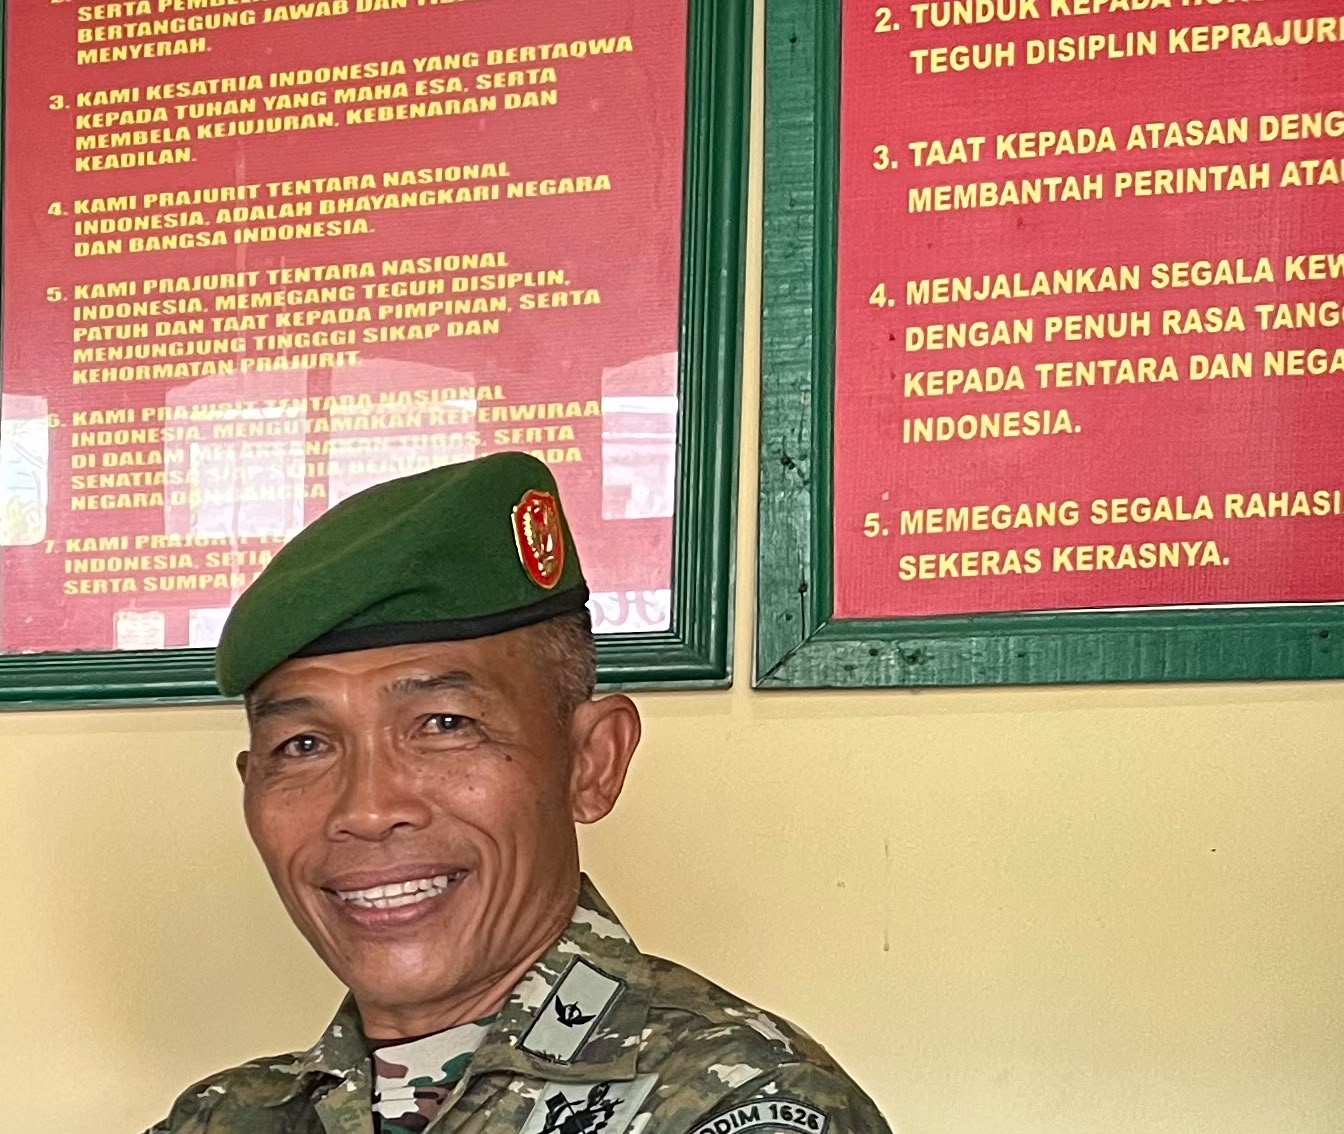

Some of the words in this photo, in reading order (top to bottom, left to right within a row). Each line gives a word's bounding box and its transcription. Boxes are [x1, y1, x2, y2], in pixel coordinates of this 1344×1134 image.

[78, 0, 151, 21] SERTA
[78, 10, 256, 43] BERTANGGUNG
[263, 0, 348, 22] JAWAB
[875, 8, 899, 32] 2.
[911, 0, 1039, 28] TUNDUK
[50, 95, 69, 109] 3.
[77, 88, 139, 107] KAMI
[147, 75, 262, 100] KESATRIA
[270, 60, 406, 87] INDONESIA
[413, 53, 478, 72] YANG
[487, 36, 632, 65] BERTAQWA
[77, 37, 212, 65] MENYERAH.
[910, 42, 1014, 74] TEGUH
[1027, 31, 1156, 64] DISIPLIN
[76, 127, 190, 150] MEMBELA
[346, 96, 497, 125] KEBENARAN
[505, 90, 557, 109] DAN
[77, 108, 167, 129] KEPADA
[175, 98, 255, 119] TUHAN
[263, 91, 326, 110] YANG
[335, 83, 408, 103] MAHA
[477, 68, 556, 89] SERTA
[76, 148, 196, 171] KEADILAN.
[873, 145, 898, 170] 3.
[909, 137, 985, 166] TAAT
[997, 127, 1116, 159] KEPADA
[1127, 117, 1247, 150] ATASAN
[48, 202, 67, 215] 4.
[75, 196, 136, 214] KAMI
[143, 184, 261, 209] PRAJURIT
[267, 175, 376, 197] TENTARA
[384, 162, 509, 187] NASIONAL
[216, 202, 312, 223] ADALAH
[319, 184, 500, 214] BHAYANGKARI
[507, 175, 611, 198] NEGARA
[909, 174, 1102, 213] MEMBANTAH
[1116, 163, 1269, 197] PERINTAH
[1280, 159, 1344, 187] ATA
[75, 240, 121, 256] DAN
[129, 231, 227, 252] BANGSA
[235, 219, 374, 243] INDONESIA.
[47, 287, 67, 301] 5.
[75, 281, 136, 299] KAMI
[144, 271, 259, 294] PRAJURIT
[267, 263, 375, 284] TENTARA
[382, 252, 508, 276] NASIONAL
[215, 287, 355, 311] MEMEGANG
[363, 279, 444, 299] TEGUH
[870, 283, 894, 307] 4.
[907, 266, 1139, 305] MENJALANKAN
[1152, 258, 1274, 288] SEGALA
[74, 324, 148, 342] PATUH
[156, 319, 203, 336] DAN
[212, 314, 268, 332] TAAT
[276, 307, 371, 327] KEPADA
[520, 290, 600, 309] SERTA
[906, 319, 1033, 351] DENGAN
[1046, 312, 1150, 341] PENUH
[1163, 307, 1245, 334] RASA
[73, 338, 246, 363] MENJUNGJUNG
[363, 324, 440, 343] SIKAP
[448, 319, 499, 336] DAN
[72, 359, 233, 384] KEHORMATAN
[905, 366, 1024, 397] KEPADA
[1035, 357, 1178, 388] TENTARA
[1190, 353, 1252, 380] DAN
[47, 413, 65, 428] 6.
[73, 409, 134, 426] KAMI
[379, 385, 506, 407] NASIONAL
[904, 409, 1080, 443] INDONESIA.
[72, 454, 95, 468] DI
[102, 449, 183, 467] DALAM
[494, 426, 574, 445] SERTA
[71, 492, 163, 511] NEGARA
[864, 513, 888, 537] 5.
[901, 501, 1078, 534] MEMEGANG
[1091, 496, 1213, 524] SEGALA
[44, 540, 61, 553] 7.
[66, 536, 128, 552] KAMI
[899, 549, 1041, 580] SEKERAS
[1053, 541, 1229, 572] KERASNYA.
[64, 578, 137, 594] SERTA
[143, 573, 245, 591] SUMPAH
[769, 1104, 819, 1130] 1626
